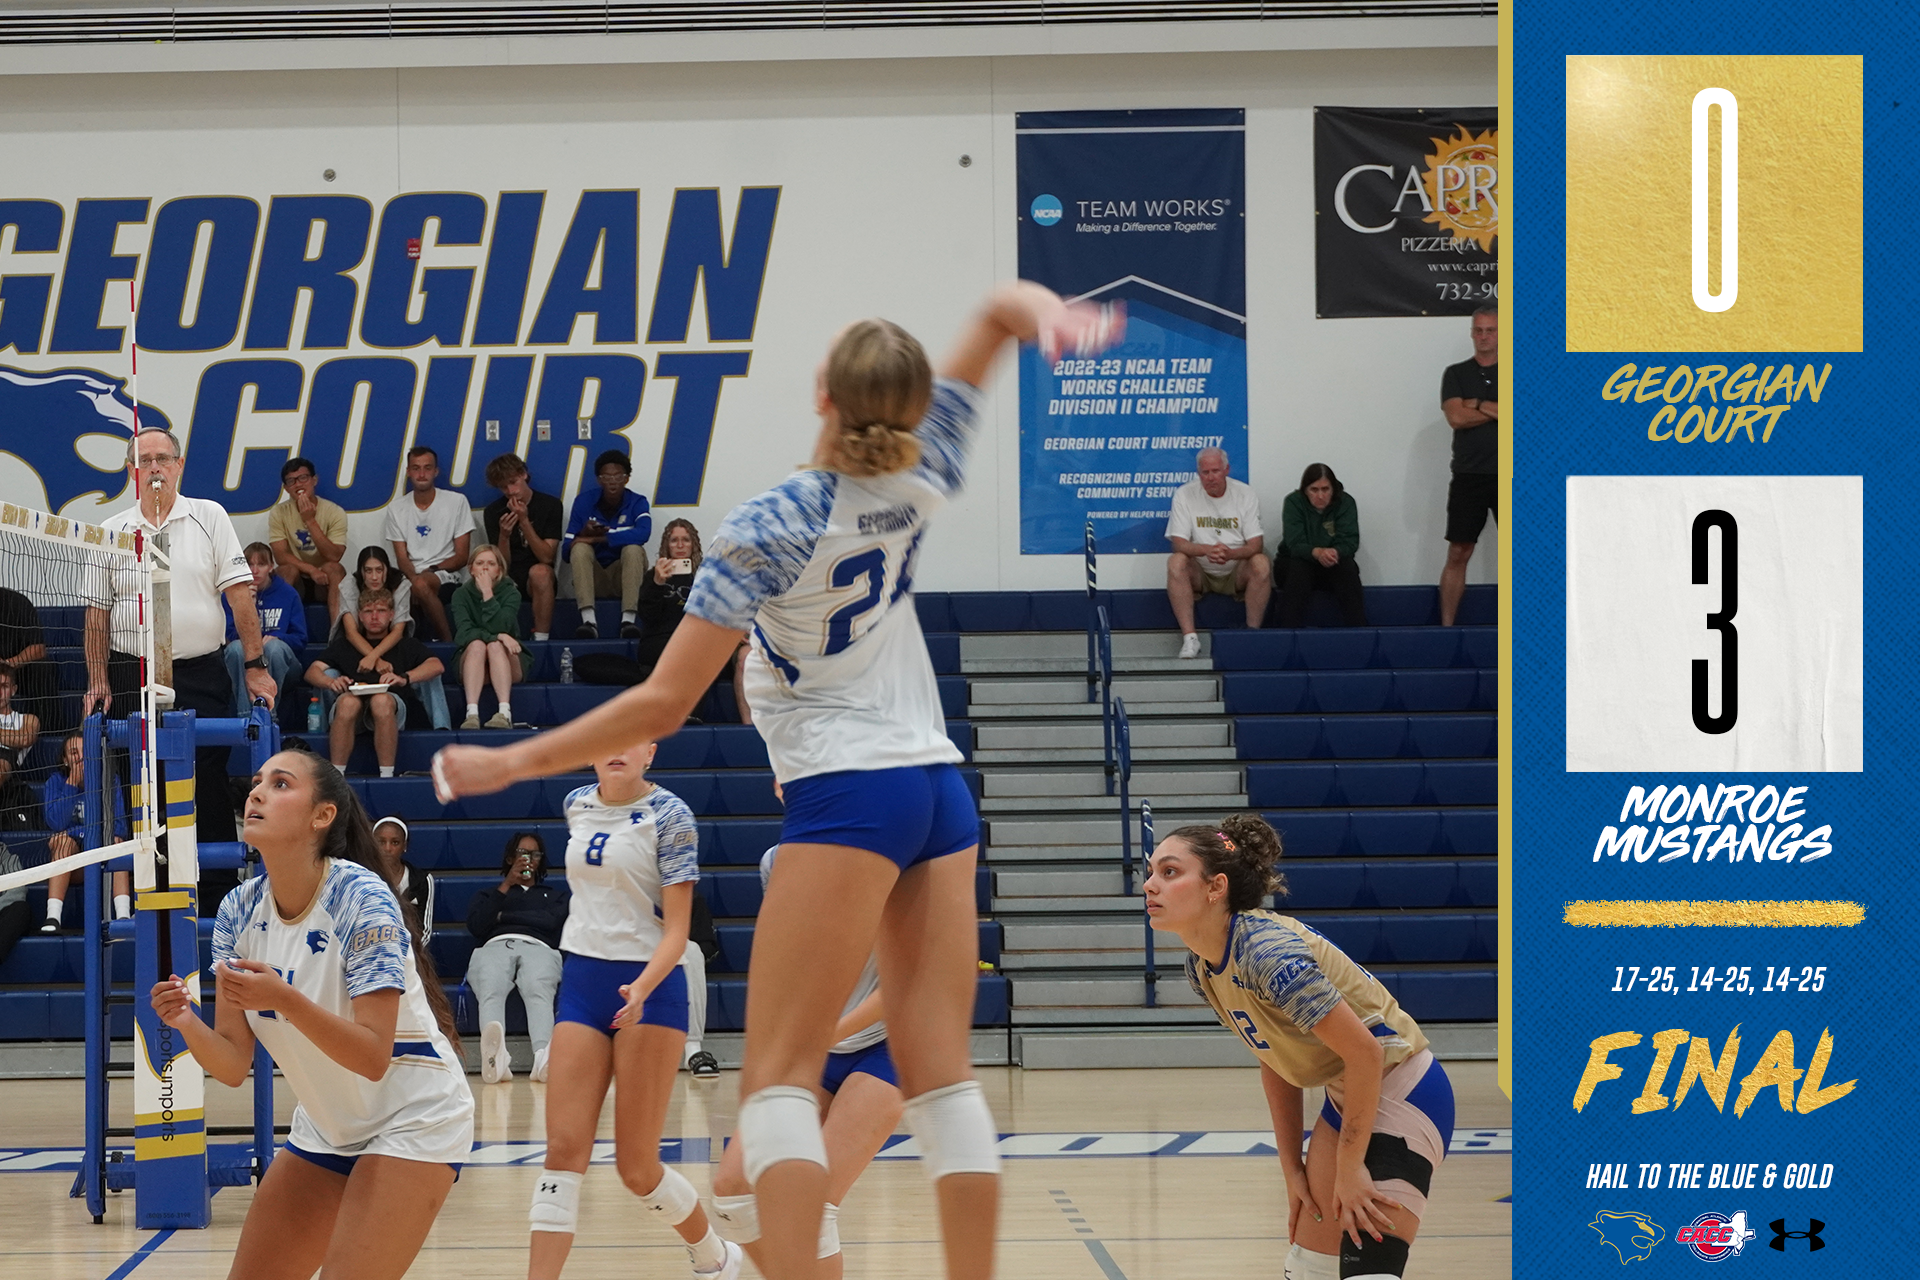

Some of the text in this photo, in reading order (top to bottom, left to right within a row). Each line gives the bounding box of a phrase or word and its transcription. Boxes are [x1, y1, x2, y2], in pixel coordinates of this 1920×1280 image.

[1334, 164, 1498, 233] CAPR
[1033, 209, 1063, 219] NCAA
[1076, 201, 1136, 218] TEAM
[1075, 223, 1111, 234] Making
[1121, 222, 1171, 232] Difference
[1401, 236, 1477, 254] PIZZERIA
[0, 185, 782, 355] GEORGIAN
[1053, 358, 1212, 376] 2022-23 NCAA TEAM
[1061, 378, 1206, 395] WORKS CHALLENGE
[1048, 397, 1219, 415] DIVISION II CHAMPION
[184, 350, 753, 515] COURT
[1043, 436, 1223, 450] GEORGIAN COURT UNIVERSITY
[1059, 472, 1199, 485] RECOGNIZING OUTSTANDIN
[1077, 486, 1176, 499] COMMUNITY SERV
[585, 832, 610, 866] 8
[1227, 1009, 1270, 1050] 12
